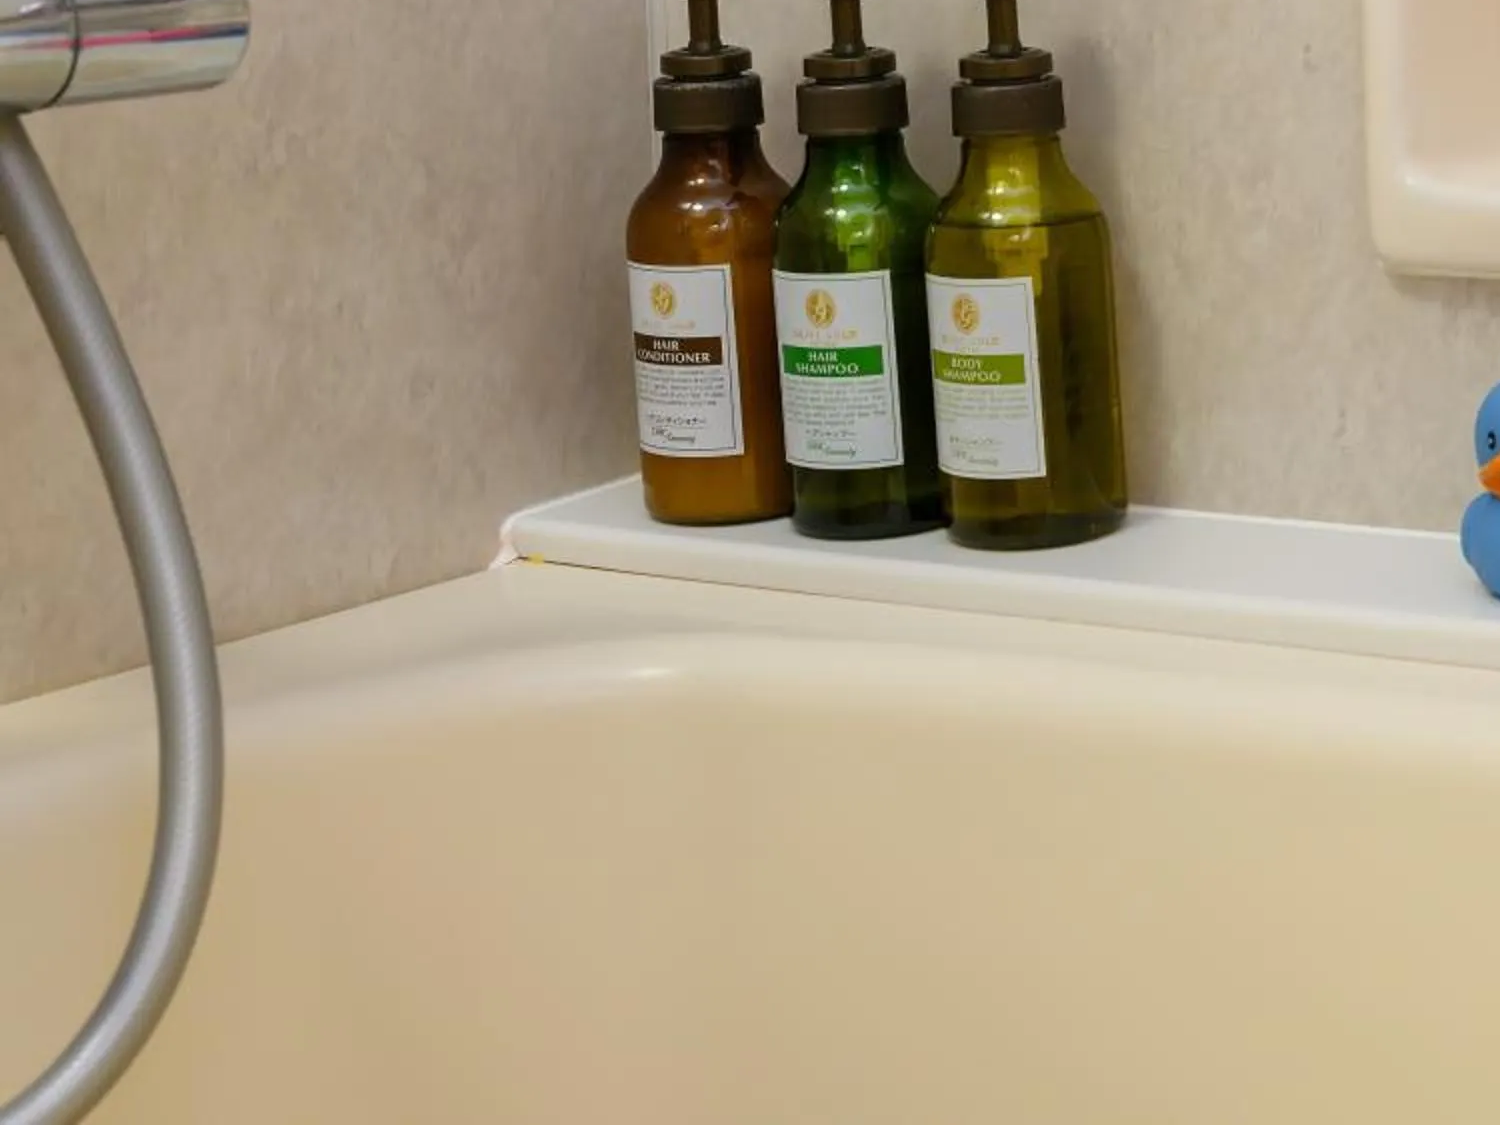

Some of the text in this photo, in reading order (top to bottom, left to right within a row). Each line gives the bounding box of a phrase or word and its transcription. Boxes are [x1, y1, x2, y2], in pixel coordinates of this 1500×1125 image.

[653, 339, 679, 351] HAIR
[637, 350, 711, 364] CONDITIONER
[808, 351, 838, 362] HAIR
[795, 362, 860, 375] SHAMPOO
[951, 358, 983, 369] BODY
